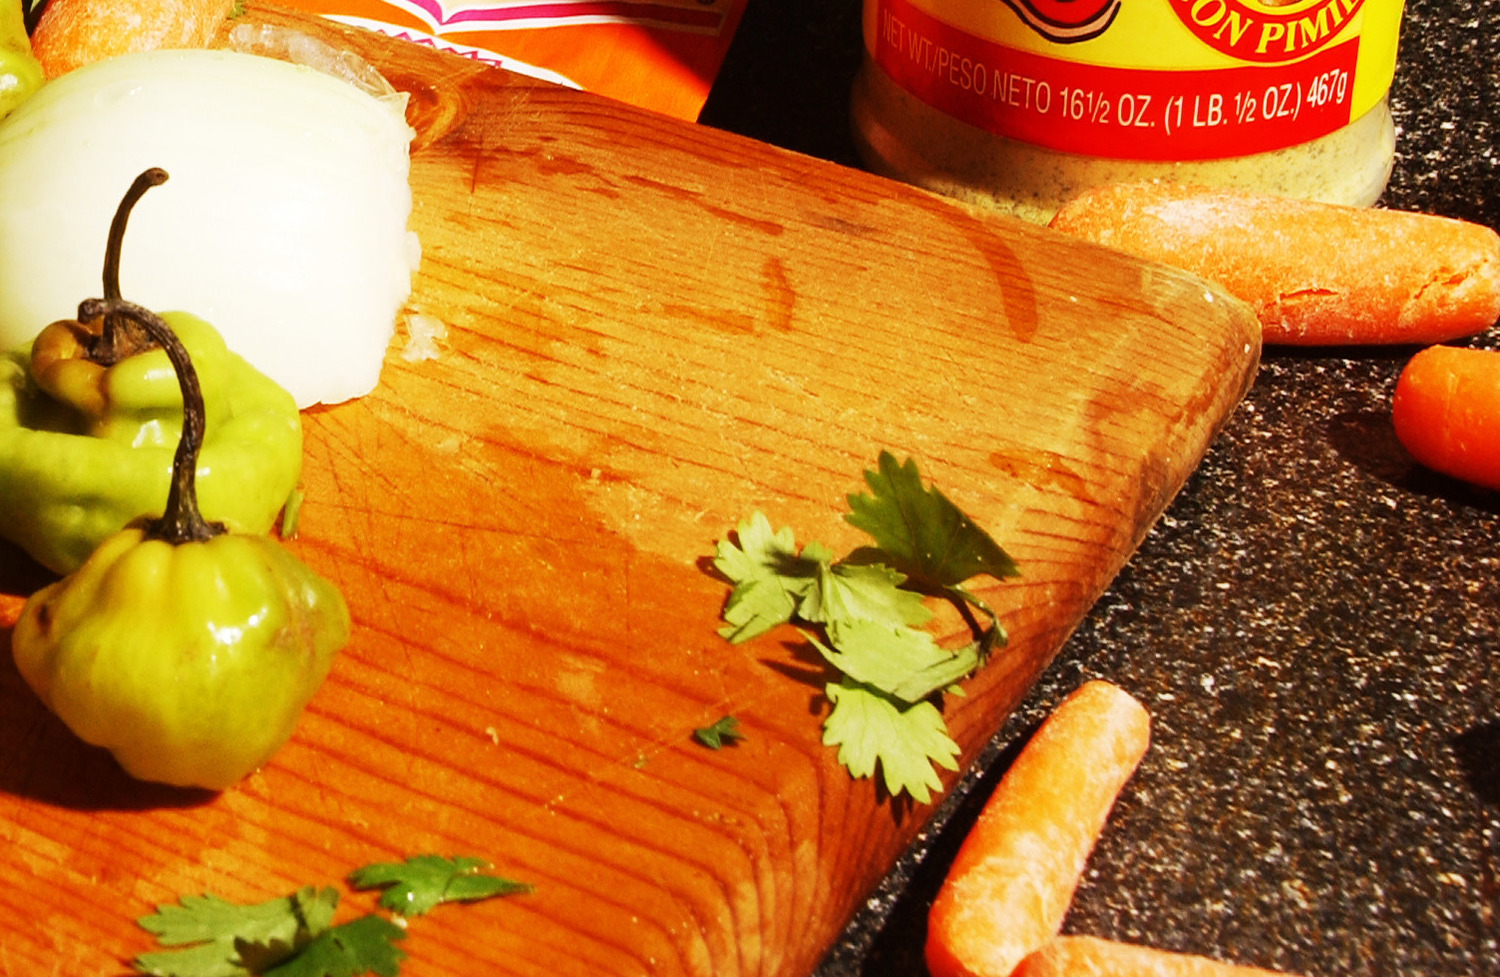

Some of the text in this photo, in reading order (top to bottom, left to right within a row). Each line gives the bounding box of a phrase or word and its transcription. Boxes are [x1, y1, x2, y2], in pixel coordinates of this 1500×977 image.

[883, 9, 905, 51] NET
[993, 70, 1051, 114] NETO
[1117, 95, 1156, 127] OZ.
[1164, 95, 1183, 135] (1
[1193, 93, 1229, 126] LB.
[1262, 81, 1301, 120] OZ.)
[1306, 69, 1348, 107] 467g
